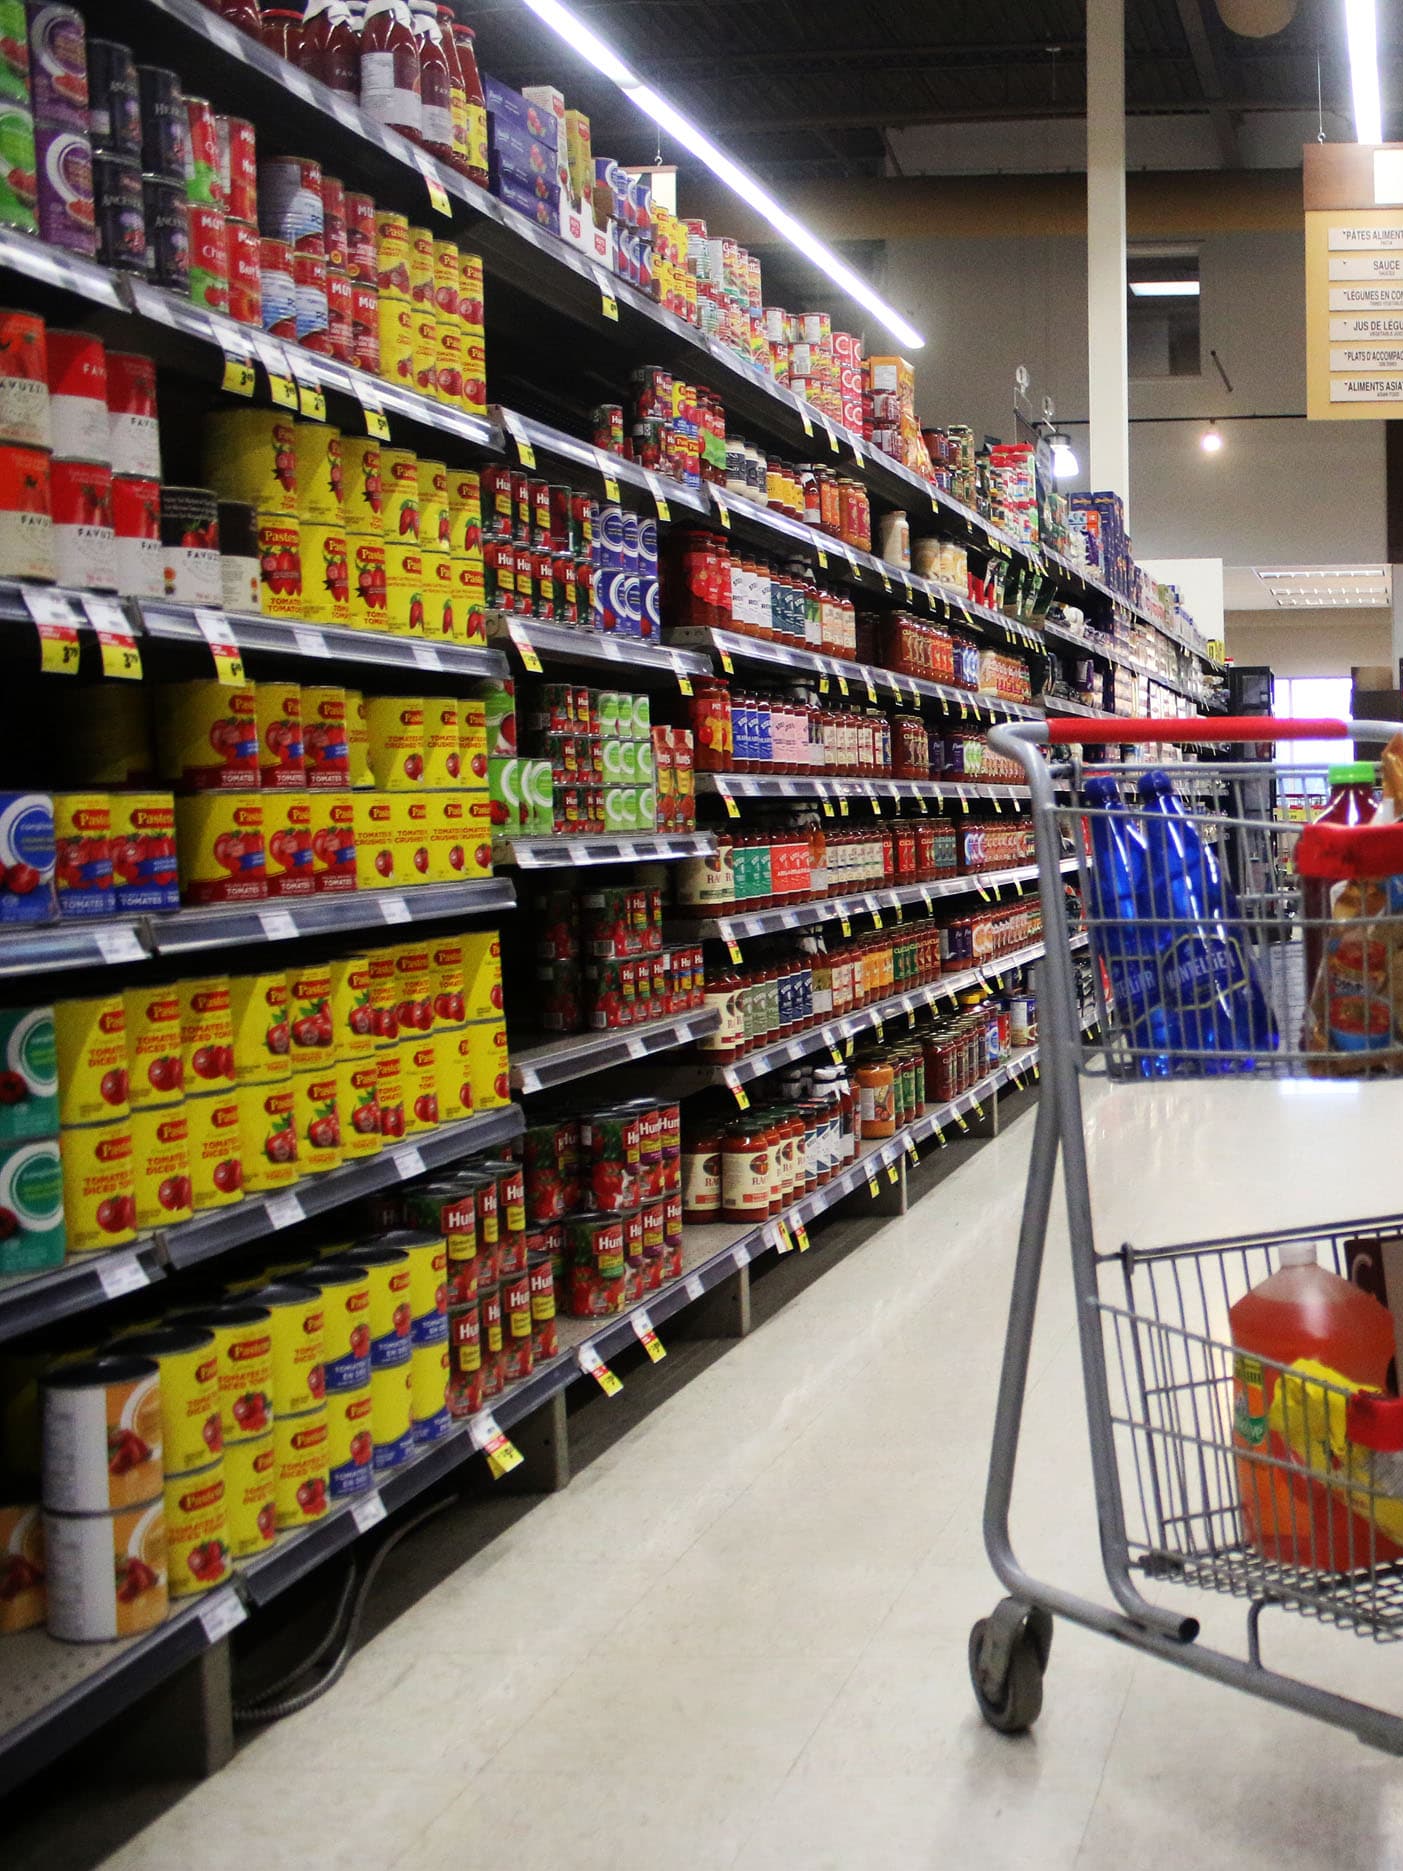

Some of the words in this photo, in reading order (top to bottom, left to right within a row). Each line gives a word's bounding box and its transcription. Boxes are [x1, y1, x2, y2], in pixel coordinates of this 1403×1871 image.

[1373, 260, 1400, 271] SAUCE
[1381, 290, 1390, 300] EN
[1353, 321, 1368, 331] JUS
[1371, 321, 1381, 330] DE
[1348, 351, 1365, 361] PLATS
[1348, 381, 1384, 392] ALIMENTS
